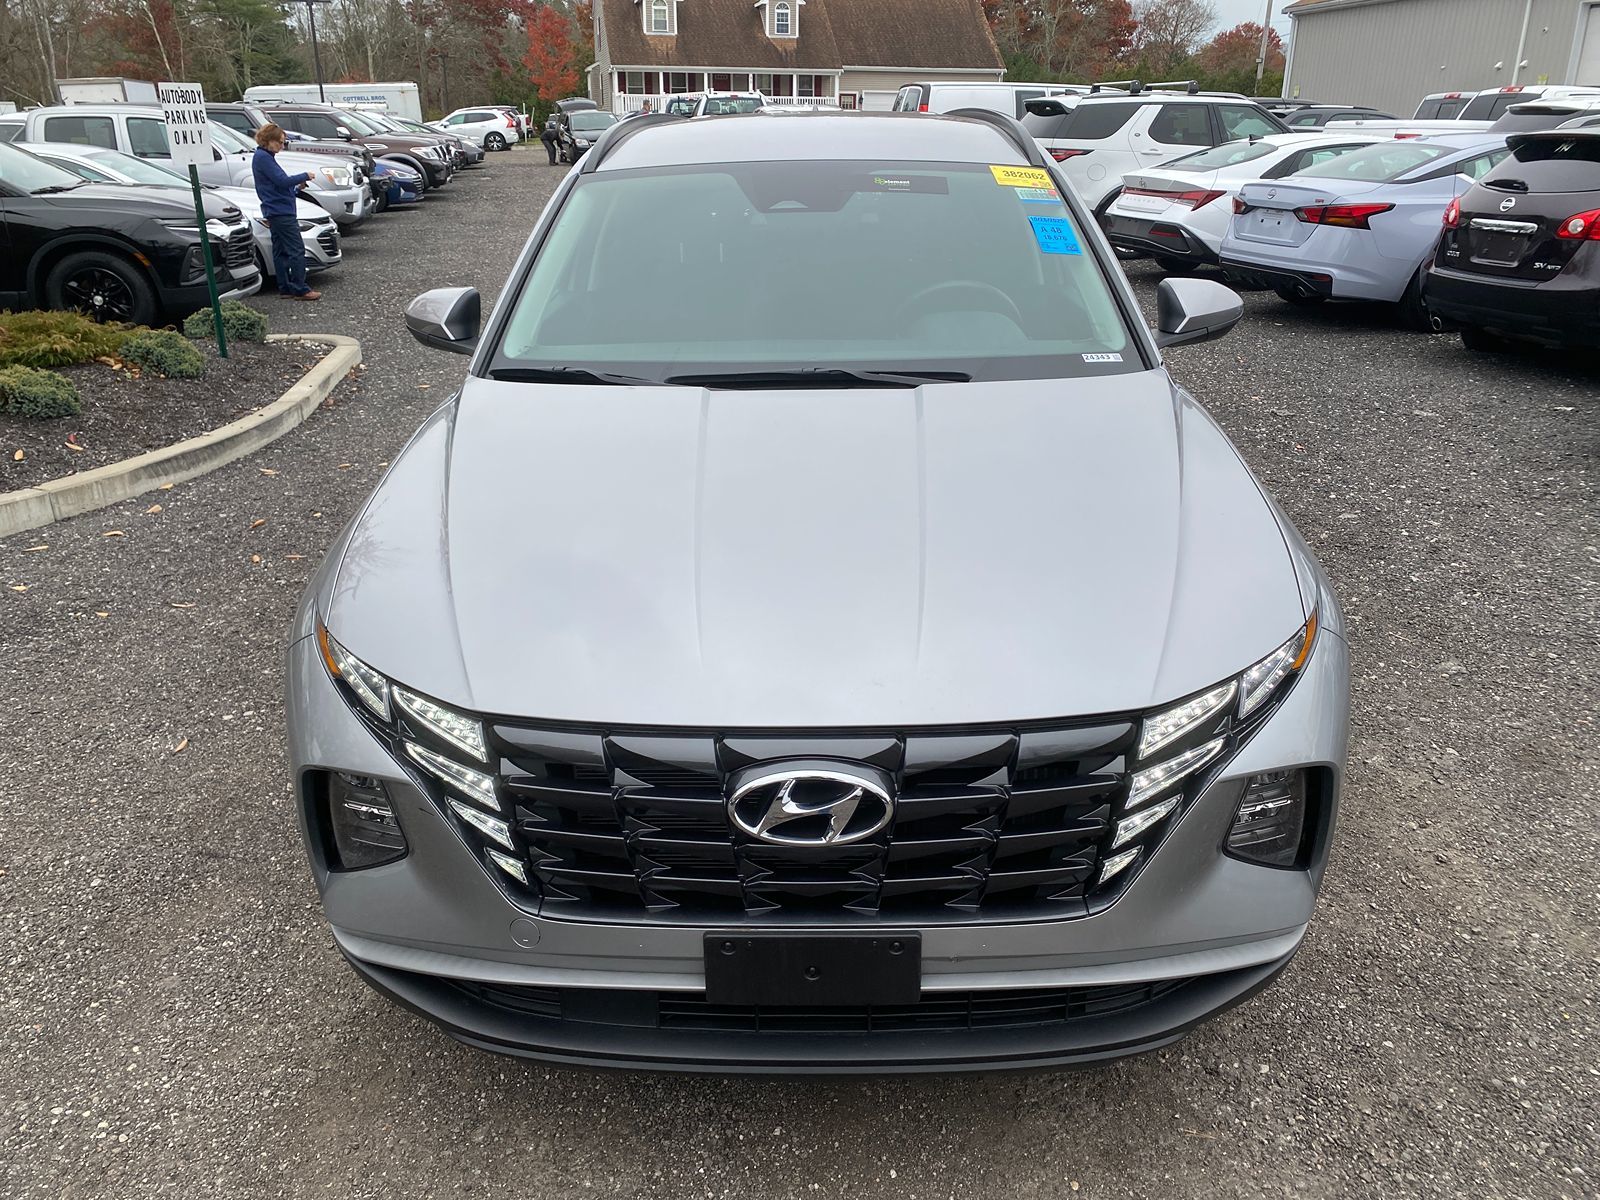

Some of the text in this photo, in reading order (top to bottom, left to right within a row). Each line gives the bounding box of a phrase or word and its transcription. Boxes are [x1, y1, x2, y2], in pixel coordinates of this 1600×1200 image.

[164, 110, 206, 124] PARKING
[174, 130, 203, 145] ONLY
[1002, 170, 1046, 181] 382062
